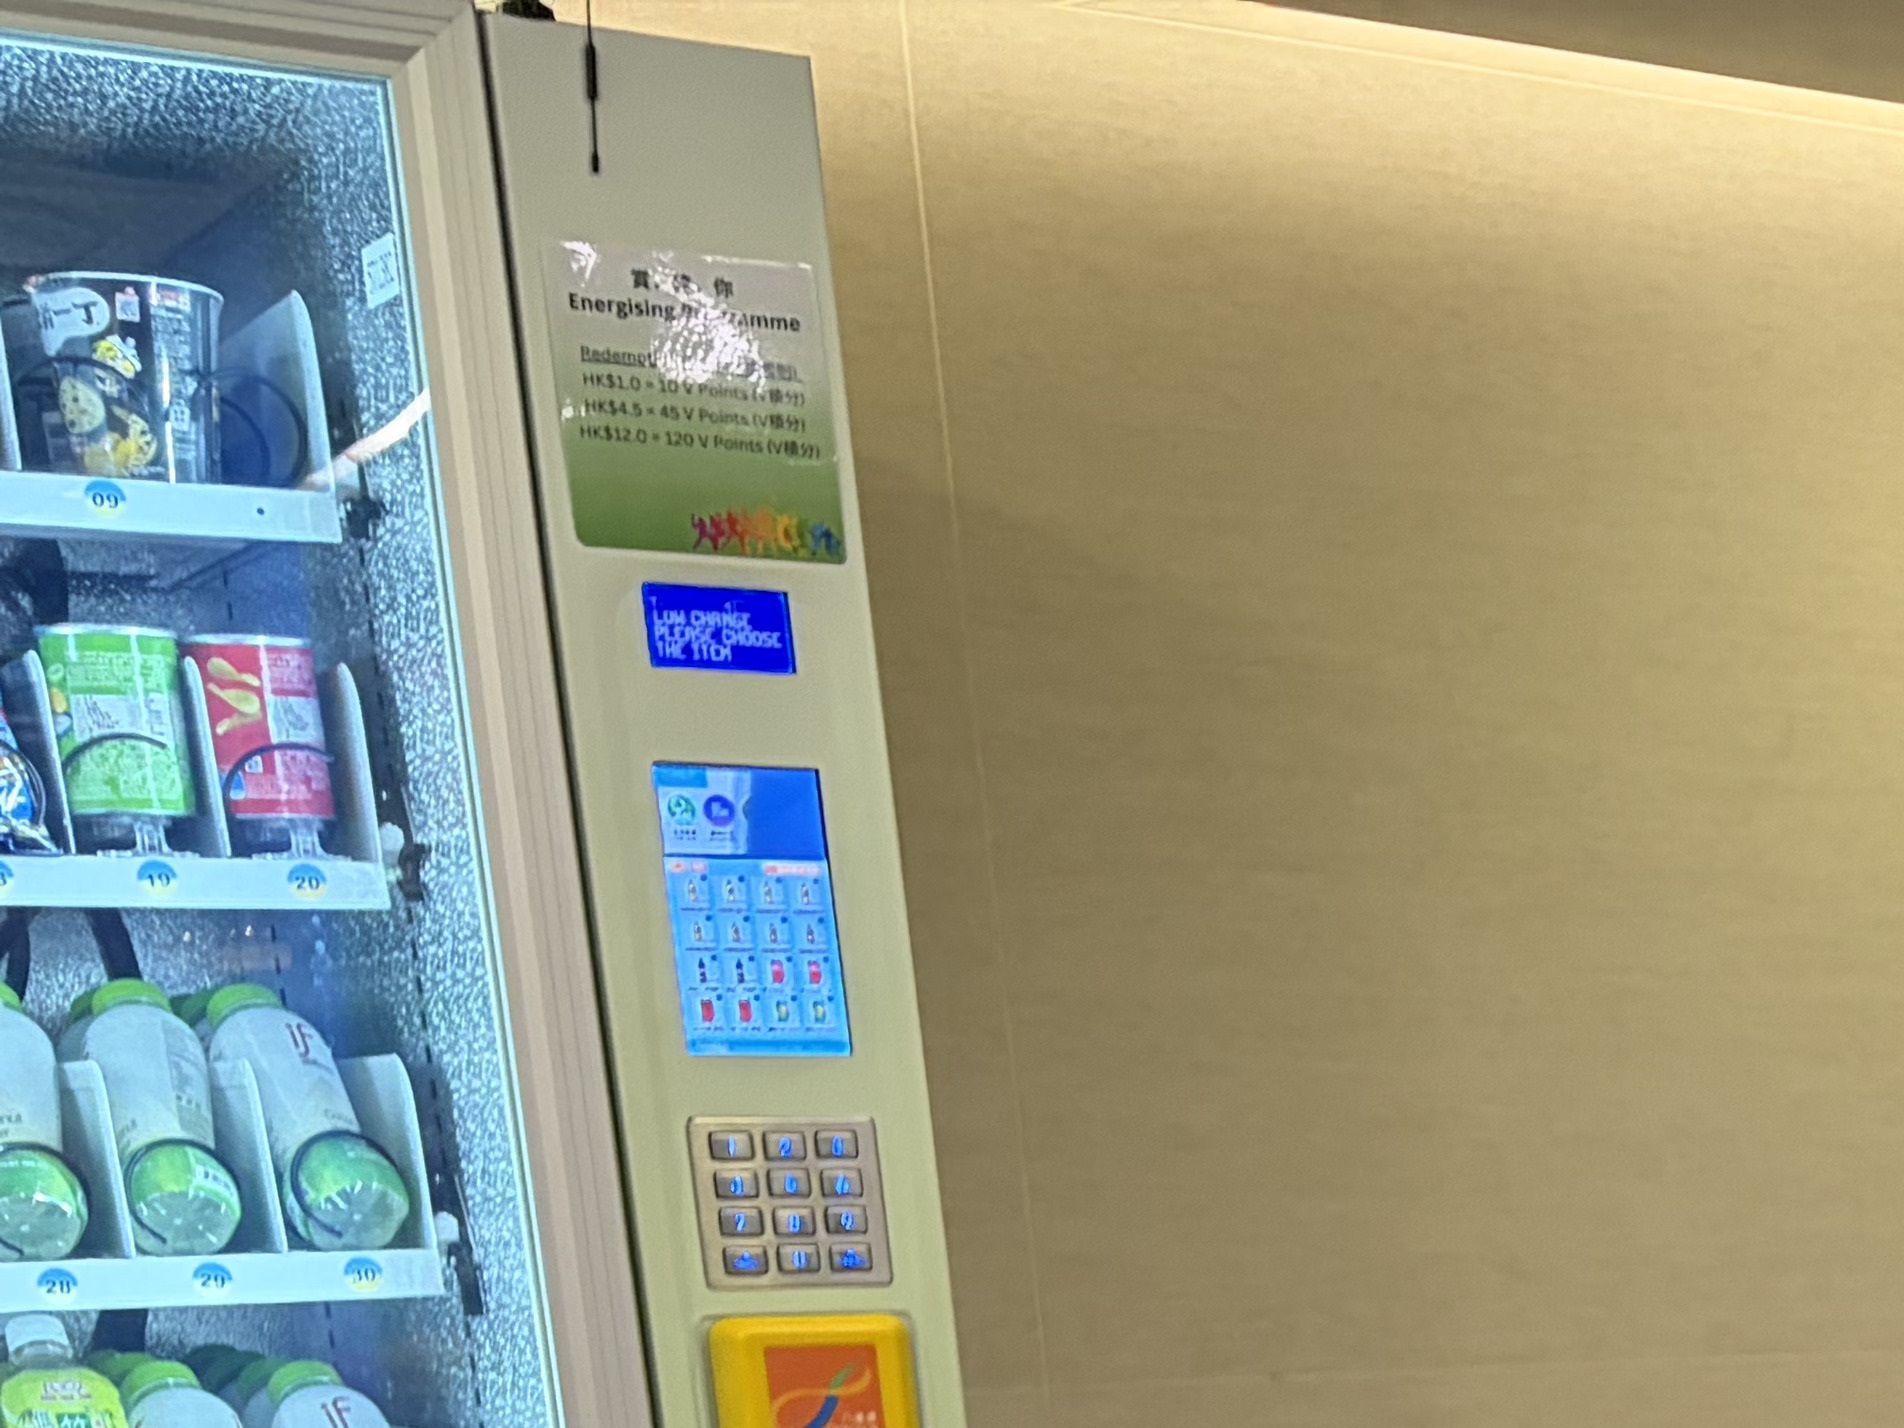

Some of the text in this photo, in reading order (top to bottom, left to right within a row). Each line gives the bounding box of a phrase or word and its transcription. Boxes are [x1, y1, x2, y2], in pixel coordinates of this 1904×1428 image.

[569, 293, 674, 323] Energising
[582, 372, 641, 392] HK$1.0
[659, 378, 678, 394] 10
[699, 383, 749, 402] Points
[584, 397, 643, 418] HK$4.5
[660, 404, 680, 421] 45
[699, 408, 750, 427] Points
[580, 424, 648, 444] HK$12.0
[665, 431, 694, 449] 120
[714, 435, 764, 454] Points
[92, 492, 119, 510] 09
[690, 610, 752, 629] CHANGE
[722, 629, 783, 649] CHOOSE
[294, 875, 319, 892] 20
